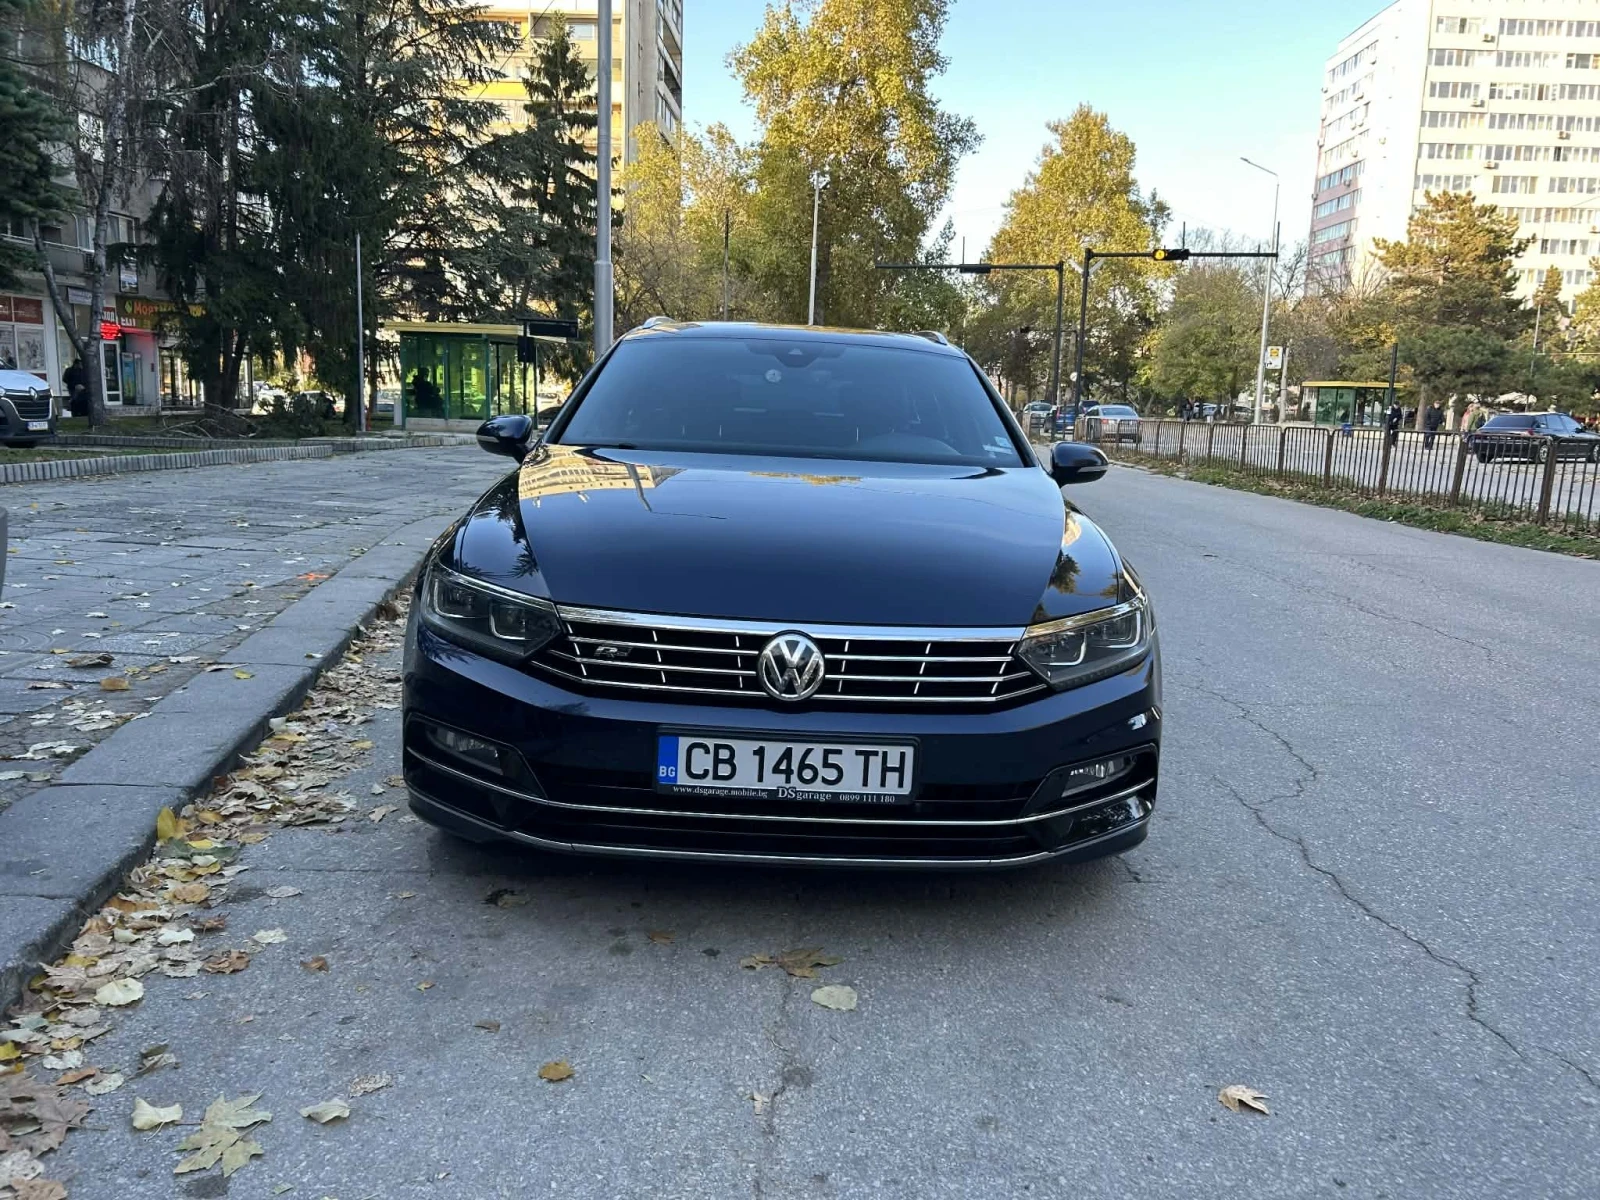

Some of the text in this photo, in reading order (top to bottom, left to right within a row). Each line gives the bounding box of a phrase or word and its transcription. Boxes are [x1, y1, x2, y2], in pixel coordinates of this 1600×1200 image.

[659, 765, 676, 778] BG
[685, 741, 906, 788] CB 1465 TH
[673, 785, 896, 803] www.dsgarage.mobile.bg DSgarage 0899 111 180
